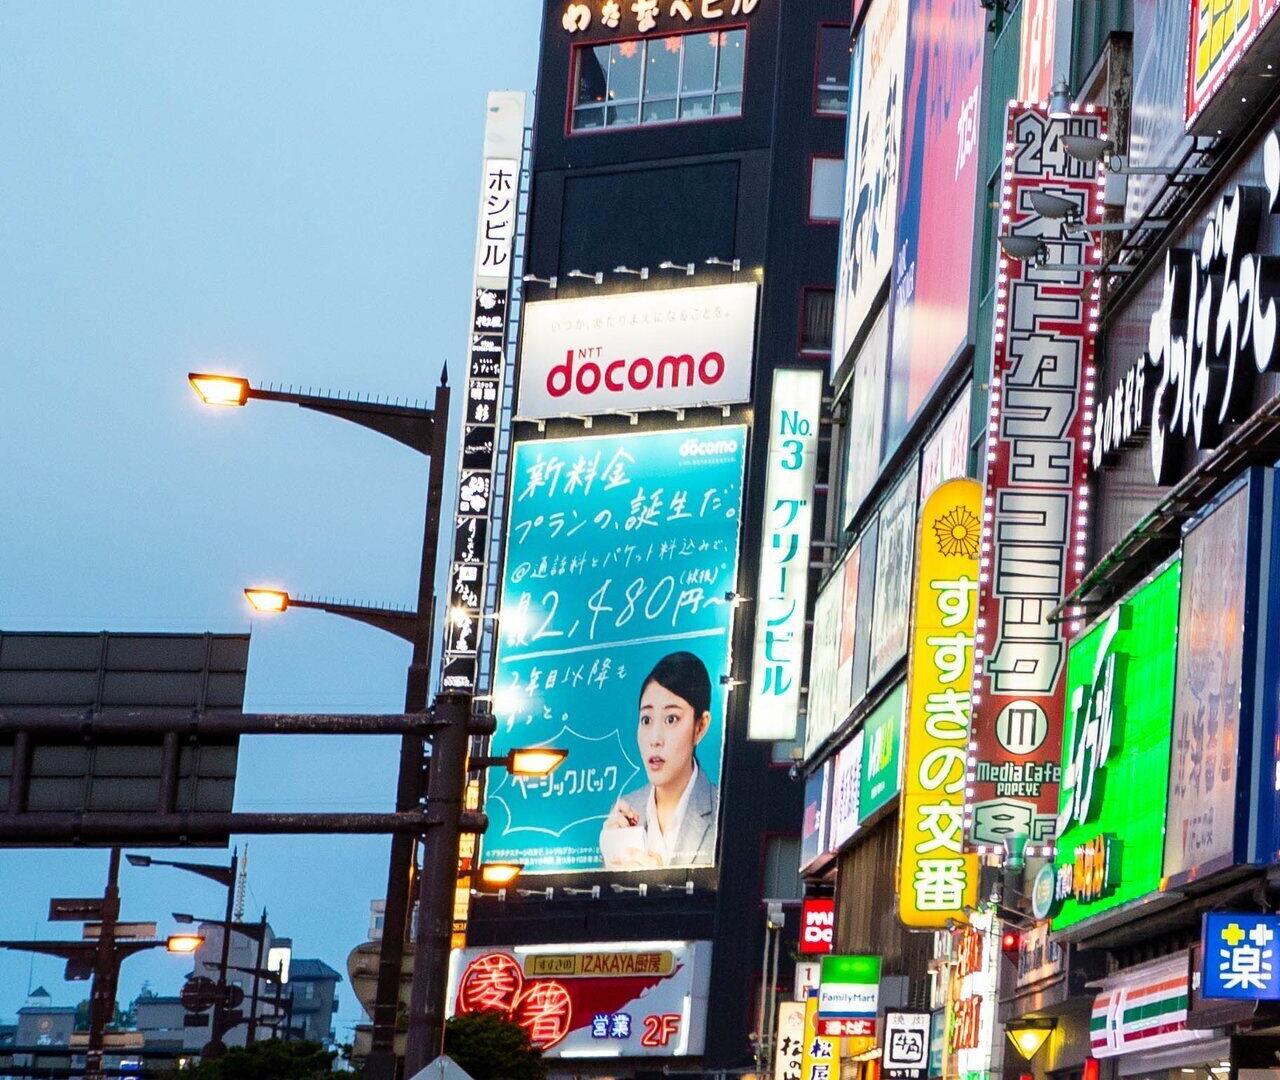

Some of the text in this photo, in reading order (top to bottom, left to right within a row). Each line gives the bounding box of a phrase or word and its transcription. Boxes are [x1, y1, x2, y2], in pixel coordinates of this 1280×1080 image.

[481, 169, 512, 268] ホシビル
[578, 346, 603, 359] NTT
[546, 350, 725, 398] docomo
[679, 438, 738, 457] docomo
[781, 442, 804, 471] 3
[517, 446, 636, 502] 新料金
[759, 499, 807, 697] グリーンビル
[913, 576, 981, 911] すすきの交番
[976, 762, 1061, 782] Media Cafe
[996, 783, 1040, 796] POPEYE
[1219, 922, 1274, 990] 薬
[822, 992, 875, 1004] FamilyMart
[643, 1014, 681, 1047] 2F
